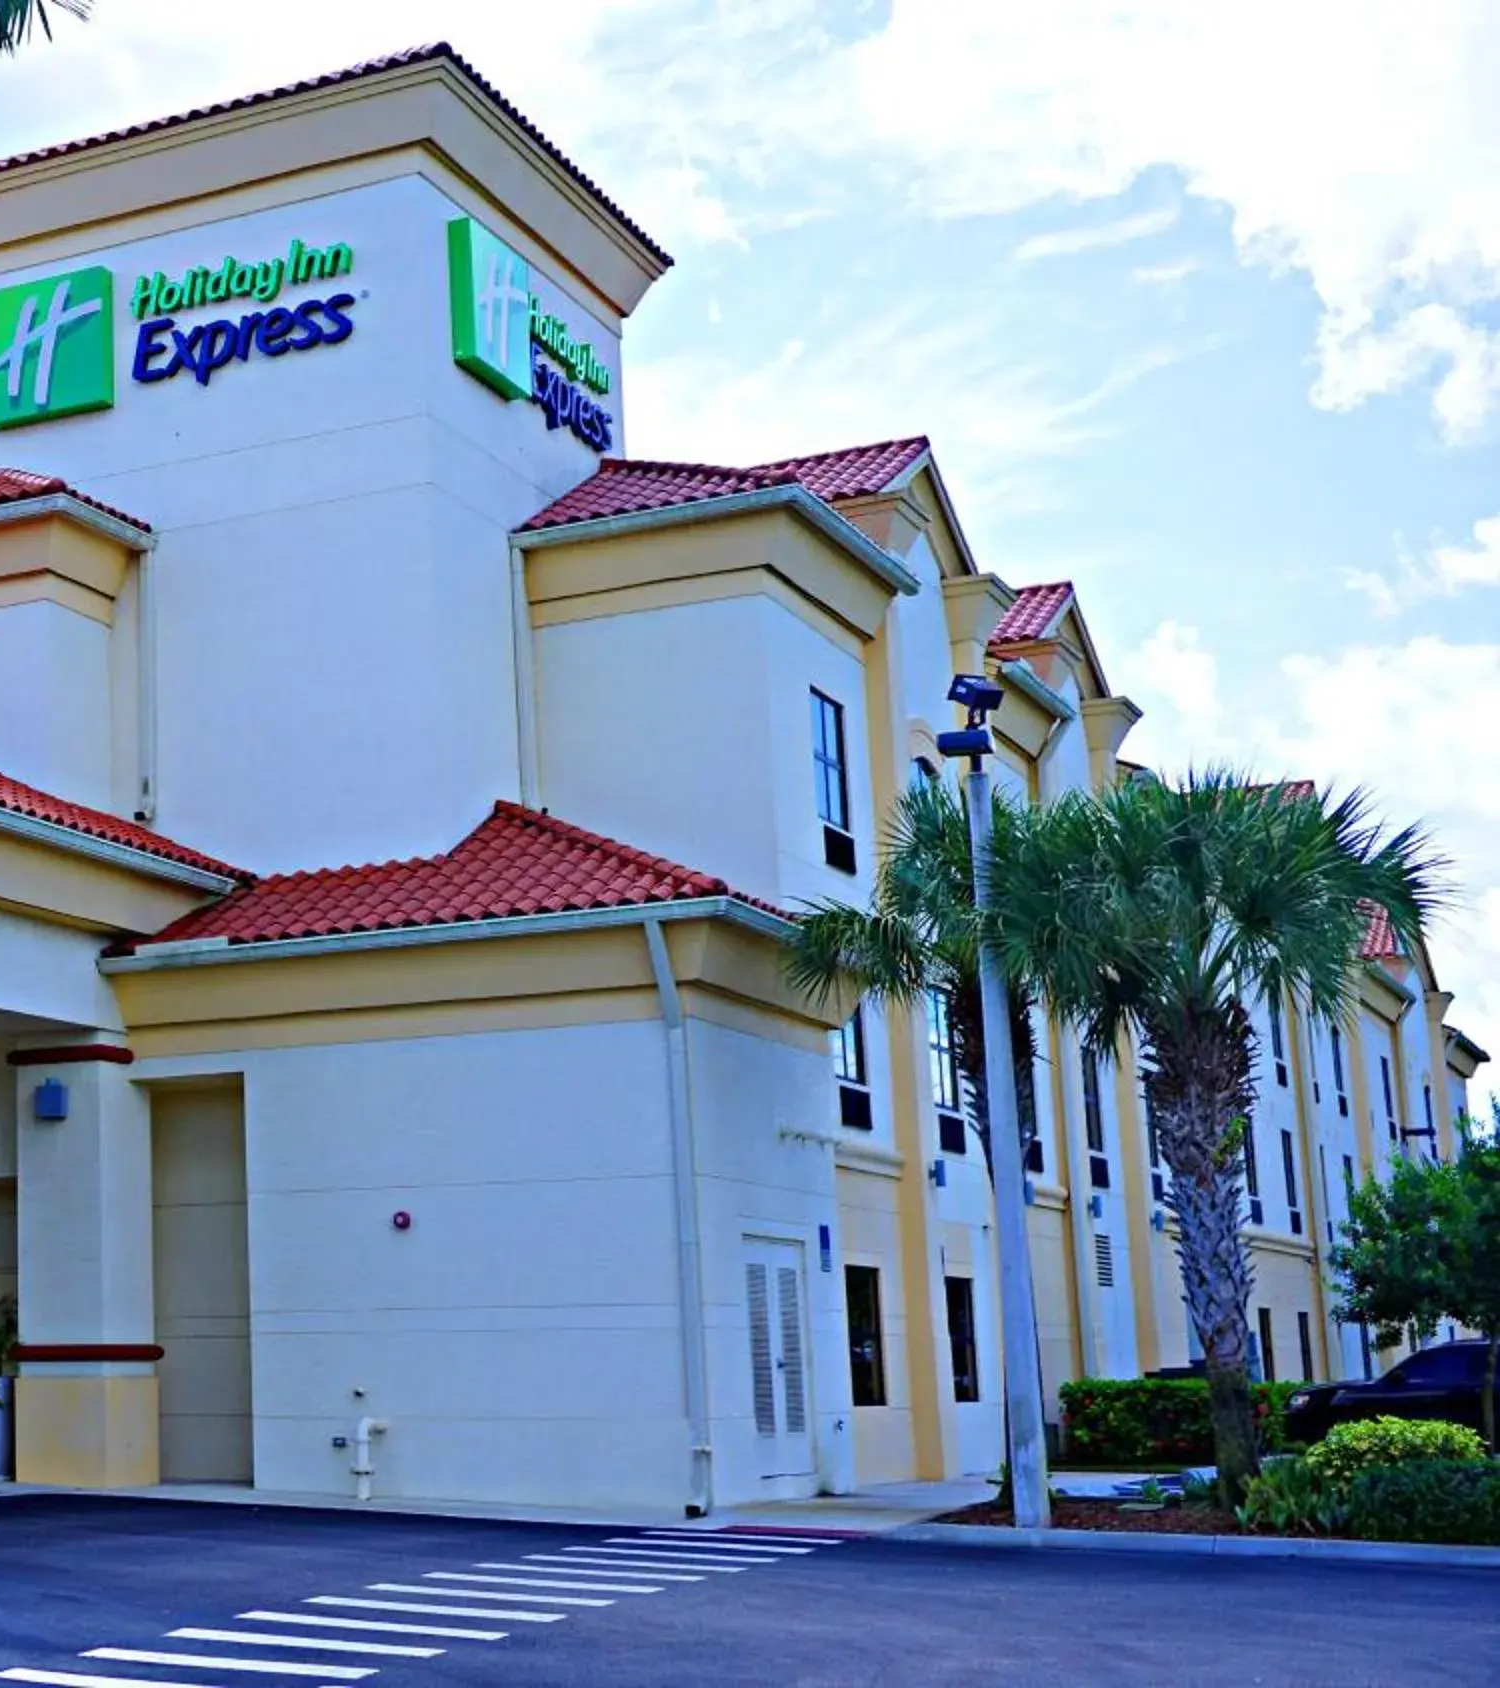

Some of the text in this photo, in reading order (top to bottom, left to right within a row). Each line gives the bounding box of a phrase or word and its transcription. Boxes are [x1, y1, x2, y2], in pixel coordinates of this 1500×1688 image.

[131, 239, 352, 319] Holiday Inn
[132, 293, 356, 387] Express
[527, 292, 611, 395] Holiday Inn
[530, 340, 613, 454] Express
